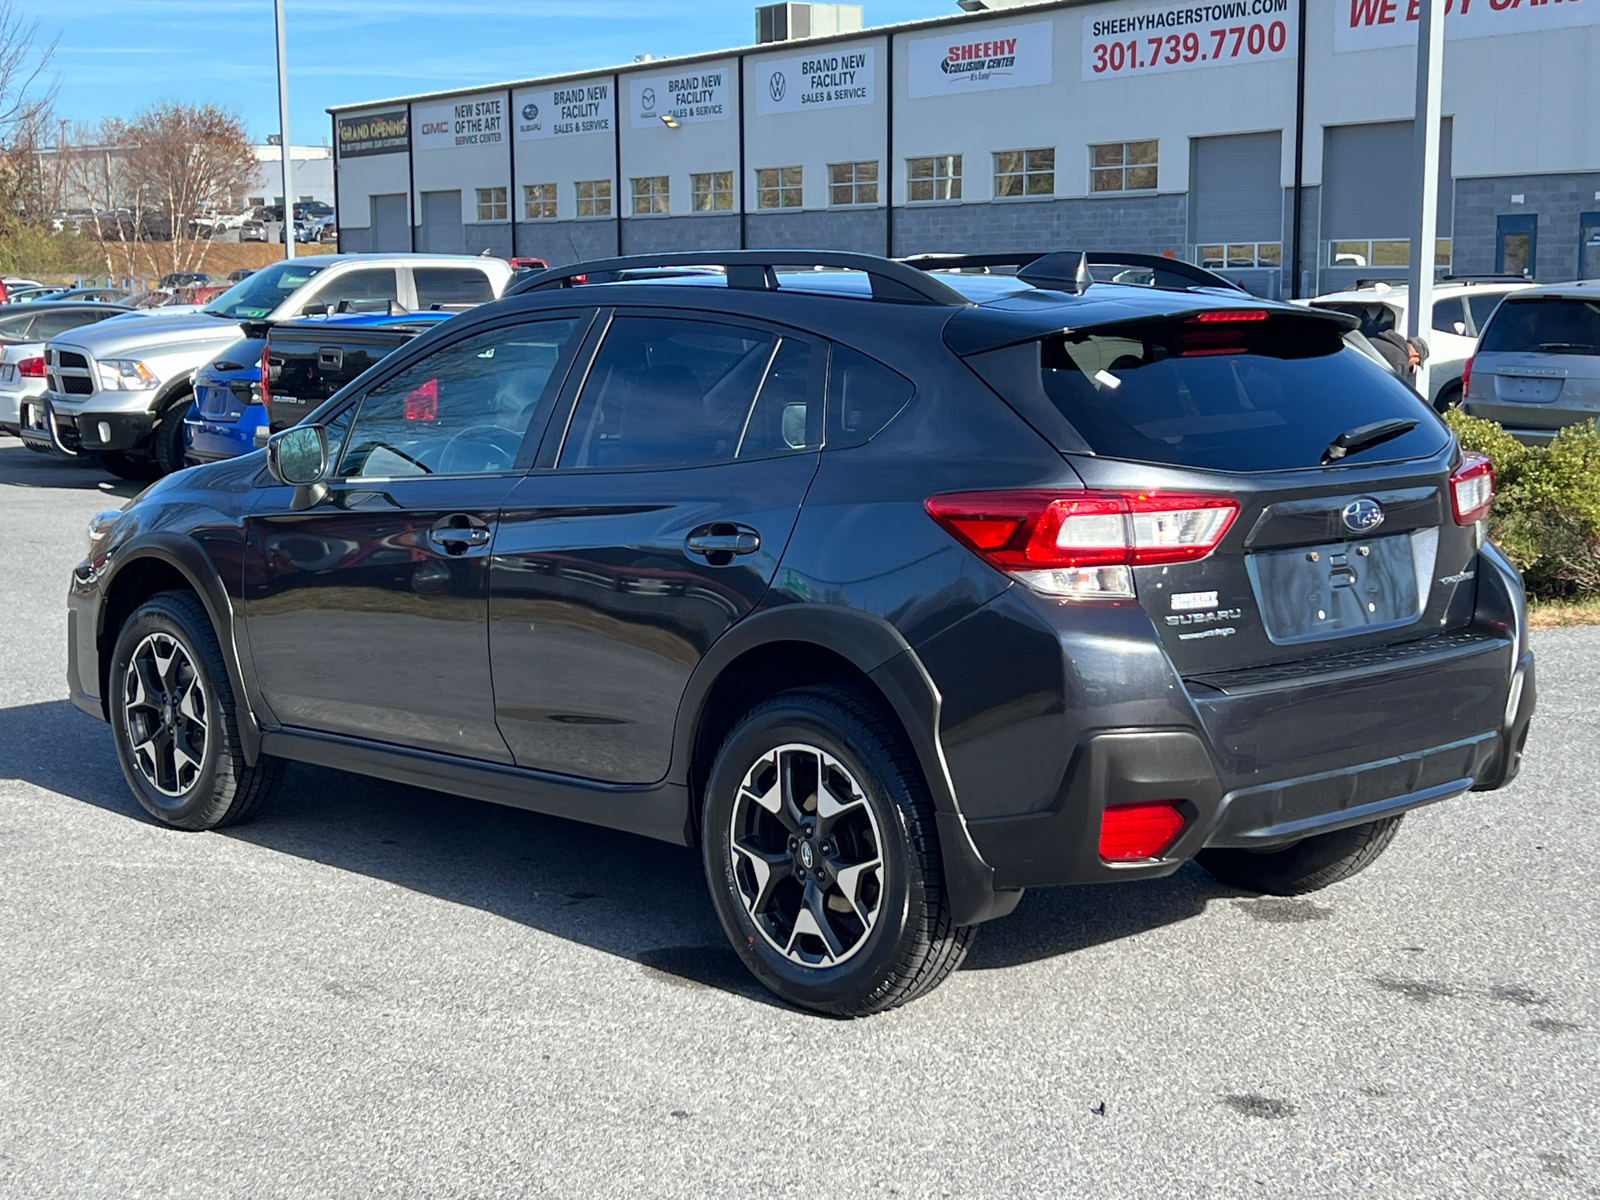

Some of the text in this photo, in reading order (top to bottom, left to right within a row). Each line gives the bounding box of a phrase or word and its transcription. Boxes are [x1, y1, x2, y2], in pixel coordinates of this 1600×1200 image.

[1092, 0, 1288, 36] SHEEHYHAGERSTOWN.COM
[948, 38, 1017, 62] SHEEHY
[1092, 20, 1287, 73] 301.739.7700
[802, 53, 866, 75] BRAND NEW
[949, 56, 1016, 74] COLLISION CENTER
[668, 74, 722, 93] BRAND NEW
[810, 71, 857, 89] FACILITY
[553, 85, 608, 106] BRAND NEW
[676, 89, 714, 106] FACILITY
[801, 87, 866, 104] SALES & SERVICE
[454, 101, 500, 119] NEW STATE
[561, 102, 600, 120] FACILITY
[668, 108, 687, 119] SALES
[689, 107, 694, 117] &
[696, 104, 722, 116] SERVICE
[340, 119, 407, 141] GRAND OPENING
[421, 122, 449, 136] GMC
[454, 116, 501, 135] OF THE ART
[520, 123, 542, 133] SUBARU
[553, 119, 609, 135] SALES & SERVICE
[454, 132, 502, 146] SERVICE CENTER
[1164, 608, 1242, 626] SUBARU
